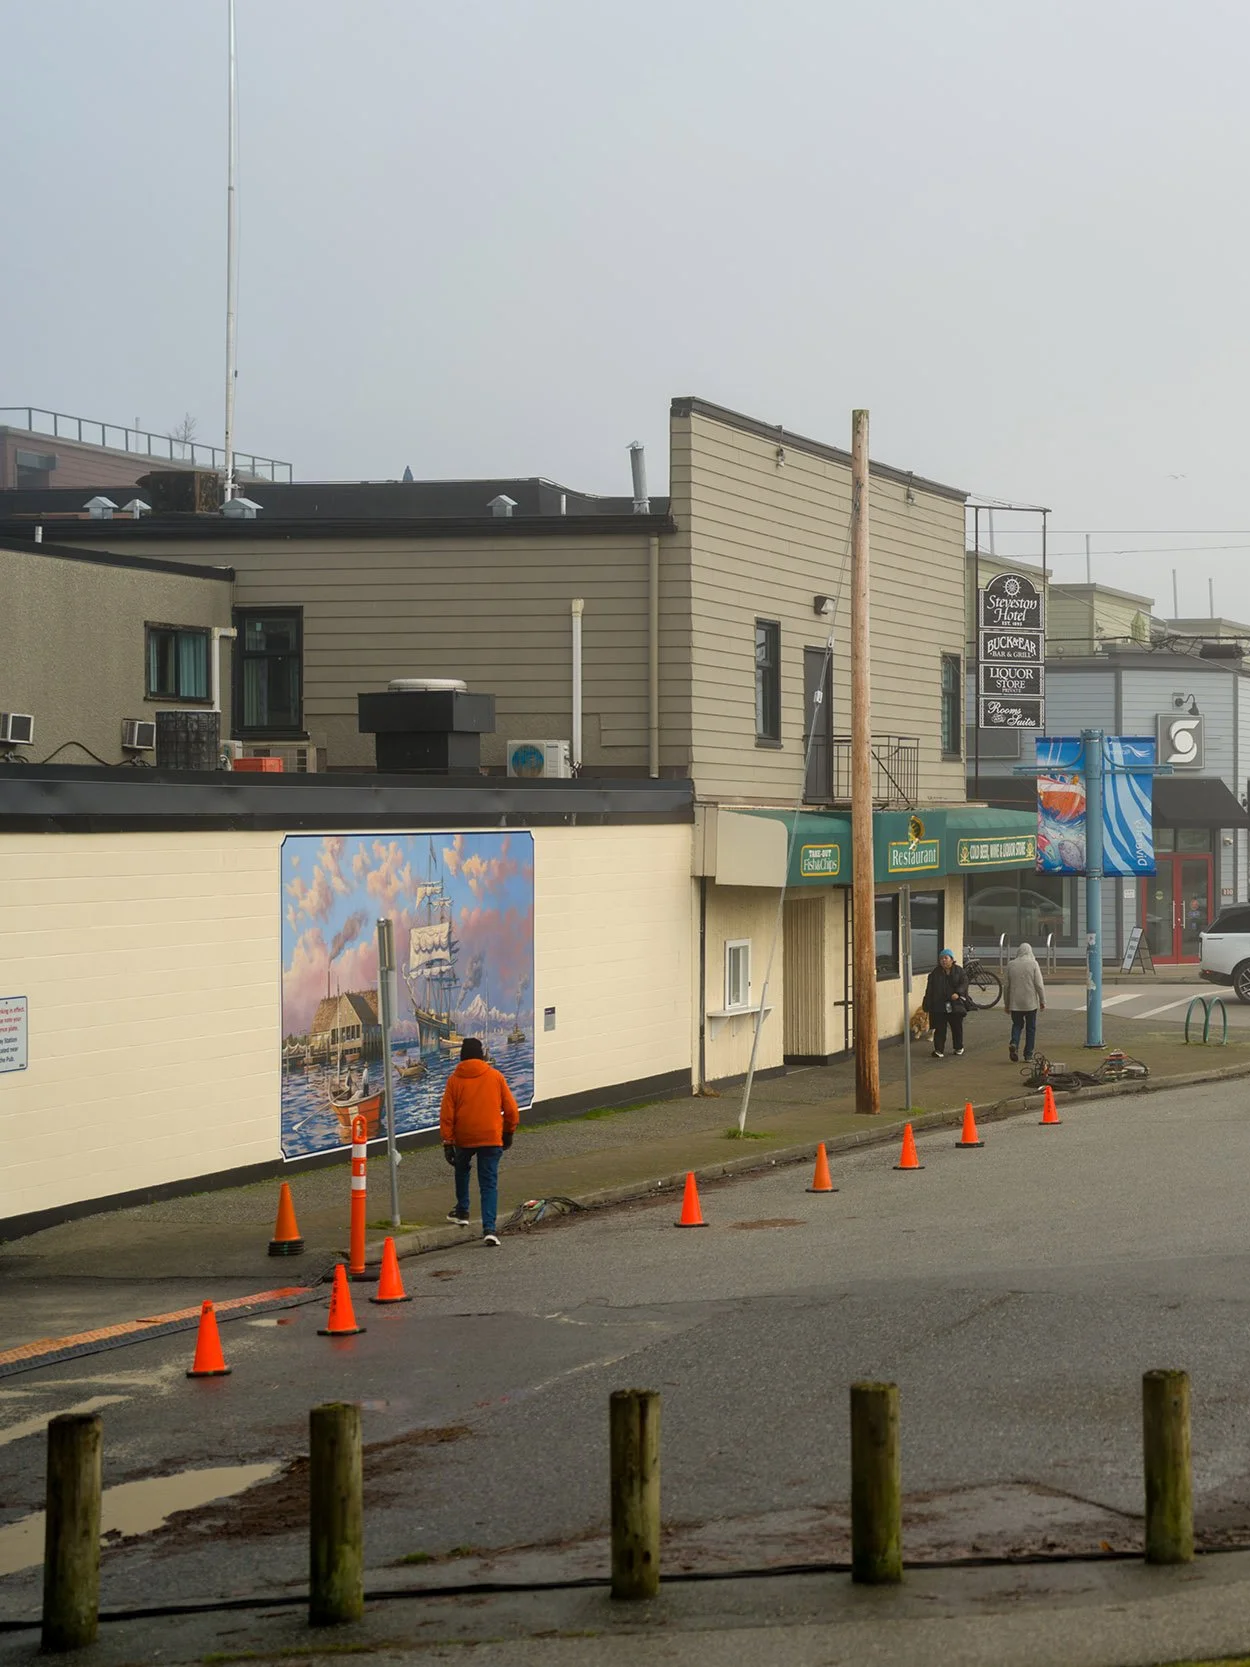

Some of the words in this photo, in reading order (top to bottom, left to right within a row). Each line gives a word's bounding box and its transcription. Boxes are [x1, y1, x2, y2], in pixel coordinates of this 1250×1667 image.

[986, 594, 1038, 610] Steveston
[993, 607, 1028, 623] Hotel
[989, 667, 1034, 680] LIQUOR
[996, 680, 1026, 689] STORE
[987, 701, 1022, 714] Rooms
[1006, 714, 1036, 726] Suites
[808, 849, 832, 858] TAKE-OUT
[892, 848, 937, 866] Restaurant
